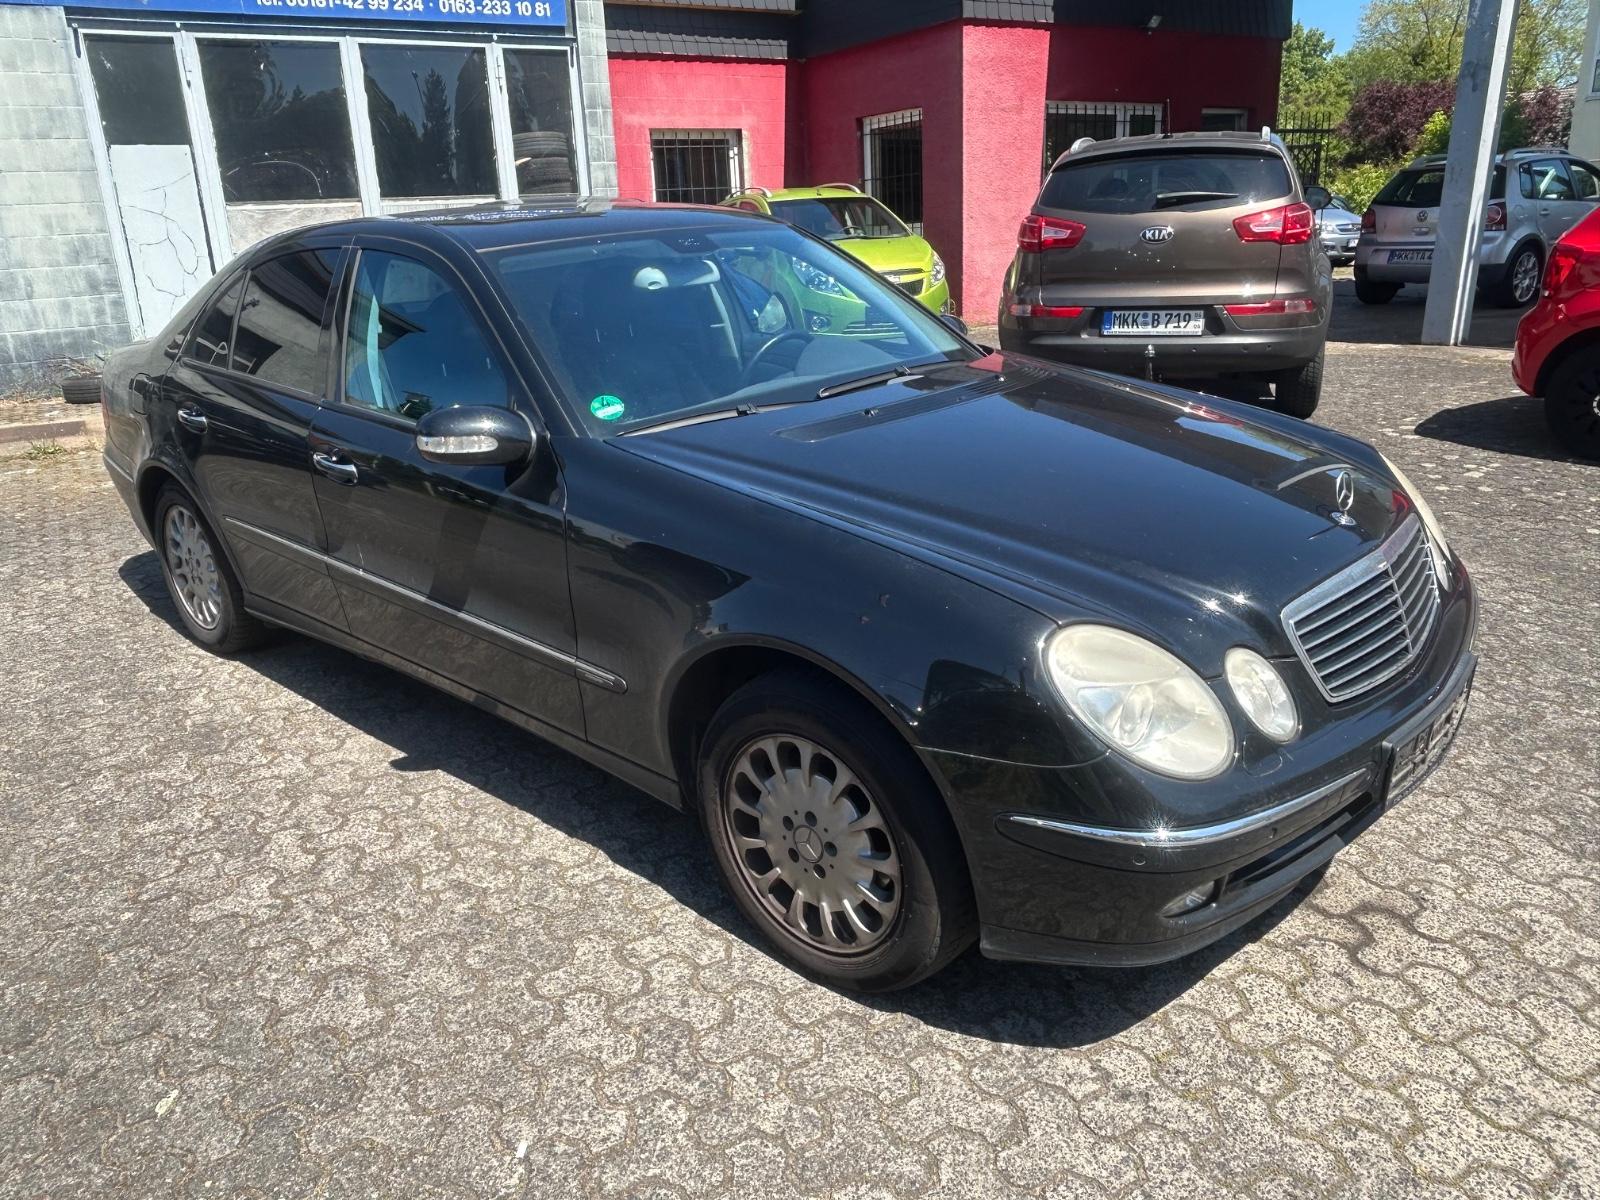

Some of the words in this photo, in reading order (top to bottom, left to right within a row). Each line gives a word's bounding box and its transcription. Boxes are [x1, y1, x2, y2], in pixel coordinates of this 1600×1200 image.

[368, 0, 389, 10] 99
[393, 0, 424, 12] 234
[439, 0, 512, 15] 0163-233
[515, 1, 532, 16] 10
[535, 2, 551, 17] 81
[1145, 229, 1168, 240] KIA
[1112, 312, 1140, 329] MKK
[1151, 312, 1160, 329] B
[1164, 312, 1192, 329] 719
